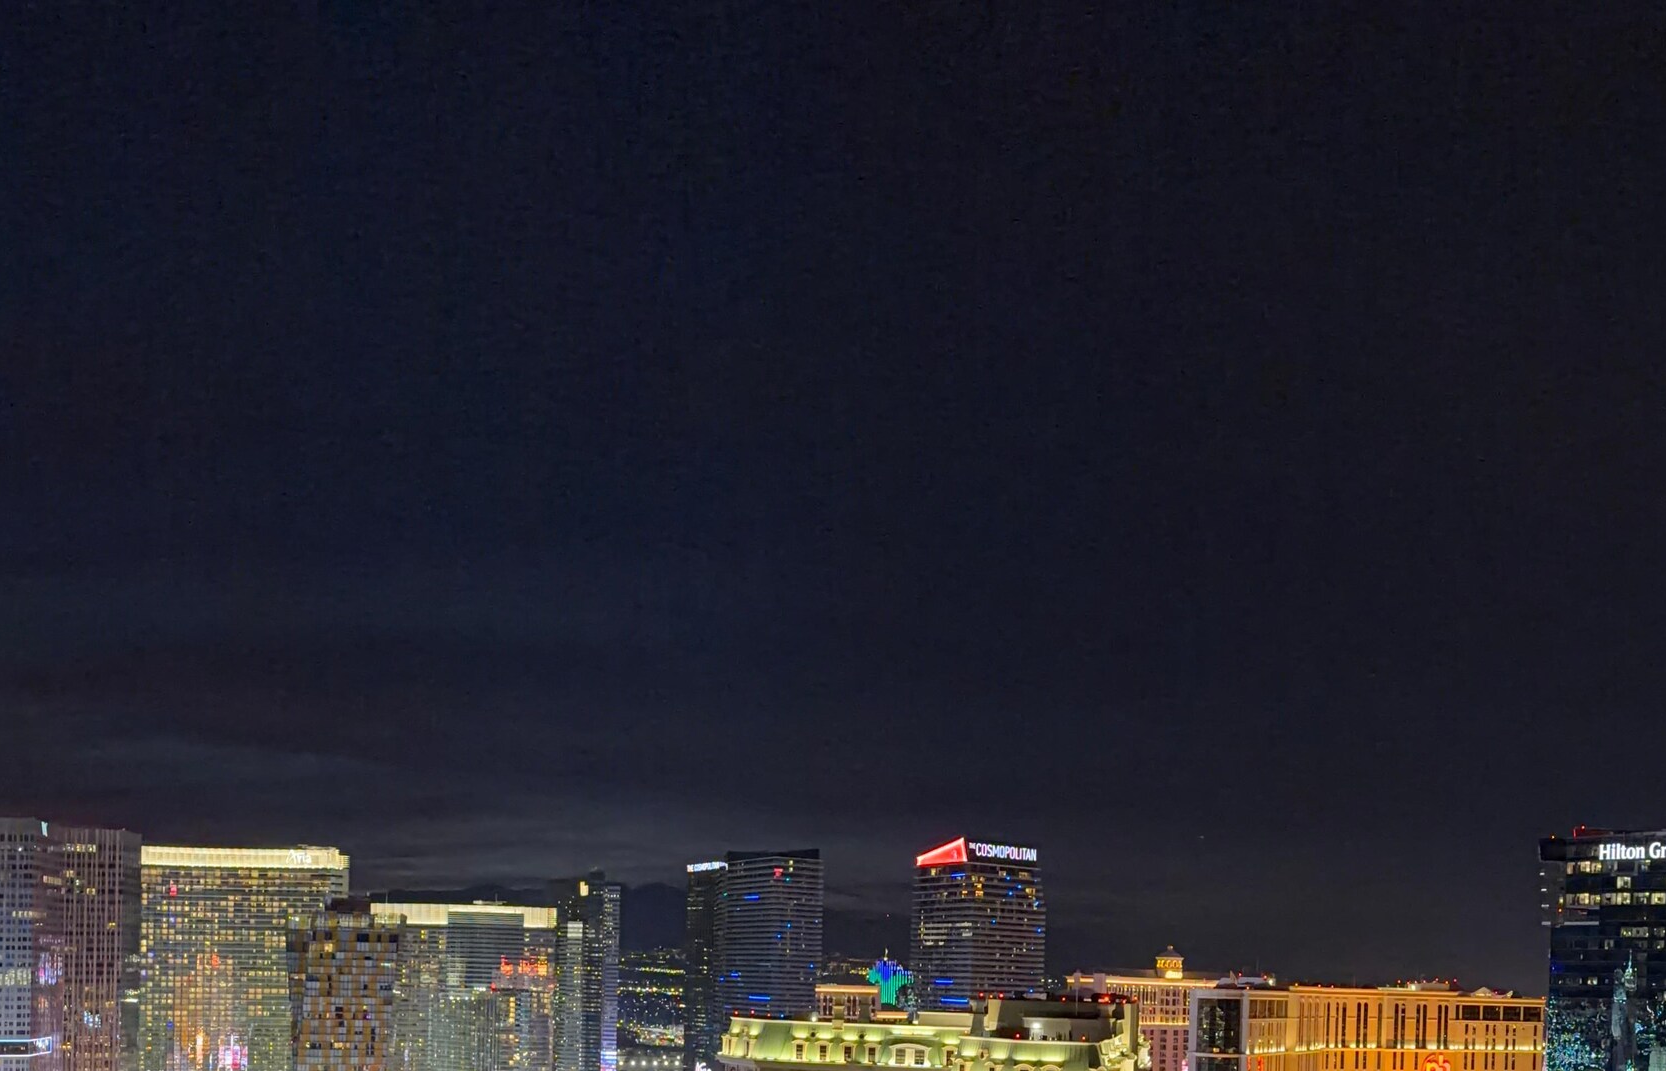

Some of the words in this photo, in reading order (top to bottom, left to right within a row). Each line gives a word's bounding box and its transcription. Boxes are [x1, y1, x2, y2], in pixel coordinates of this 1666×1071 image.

[285, 848, 312, 865] Aria
[975, 842, 1038, 862] COSMOPOLITAN
[1598, 843, 1646, 861] Hilton
